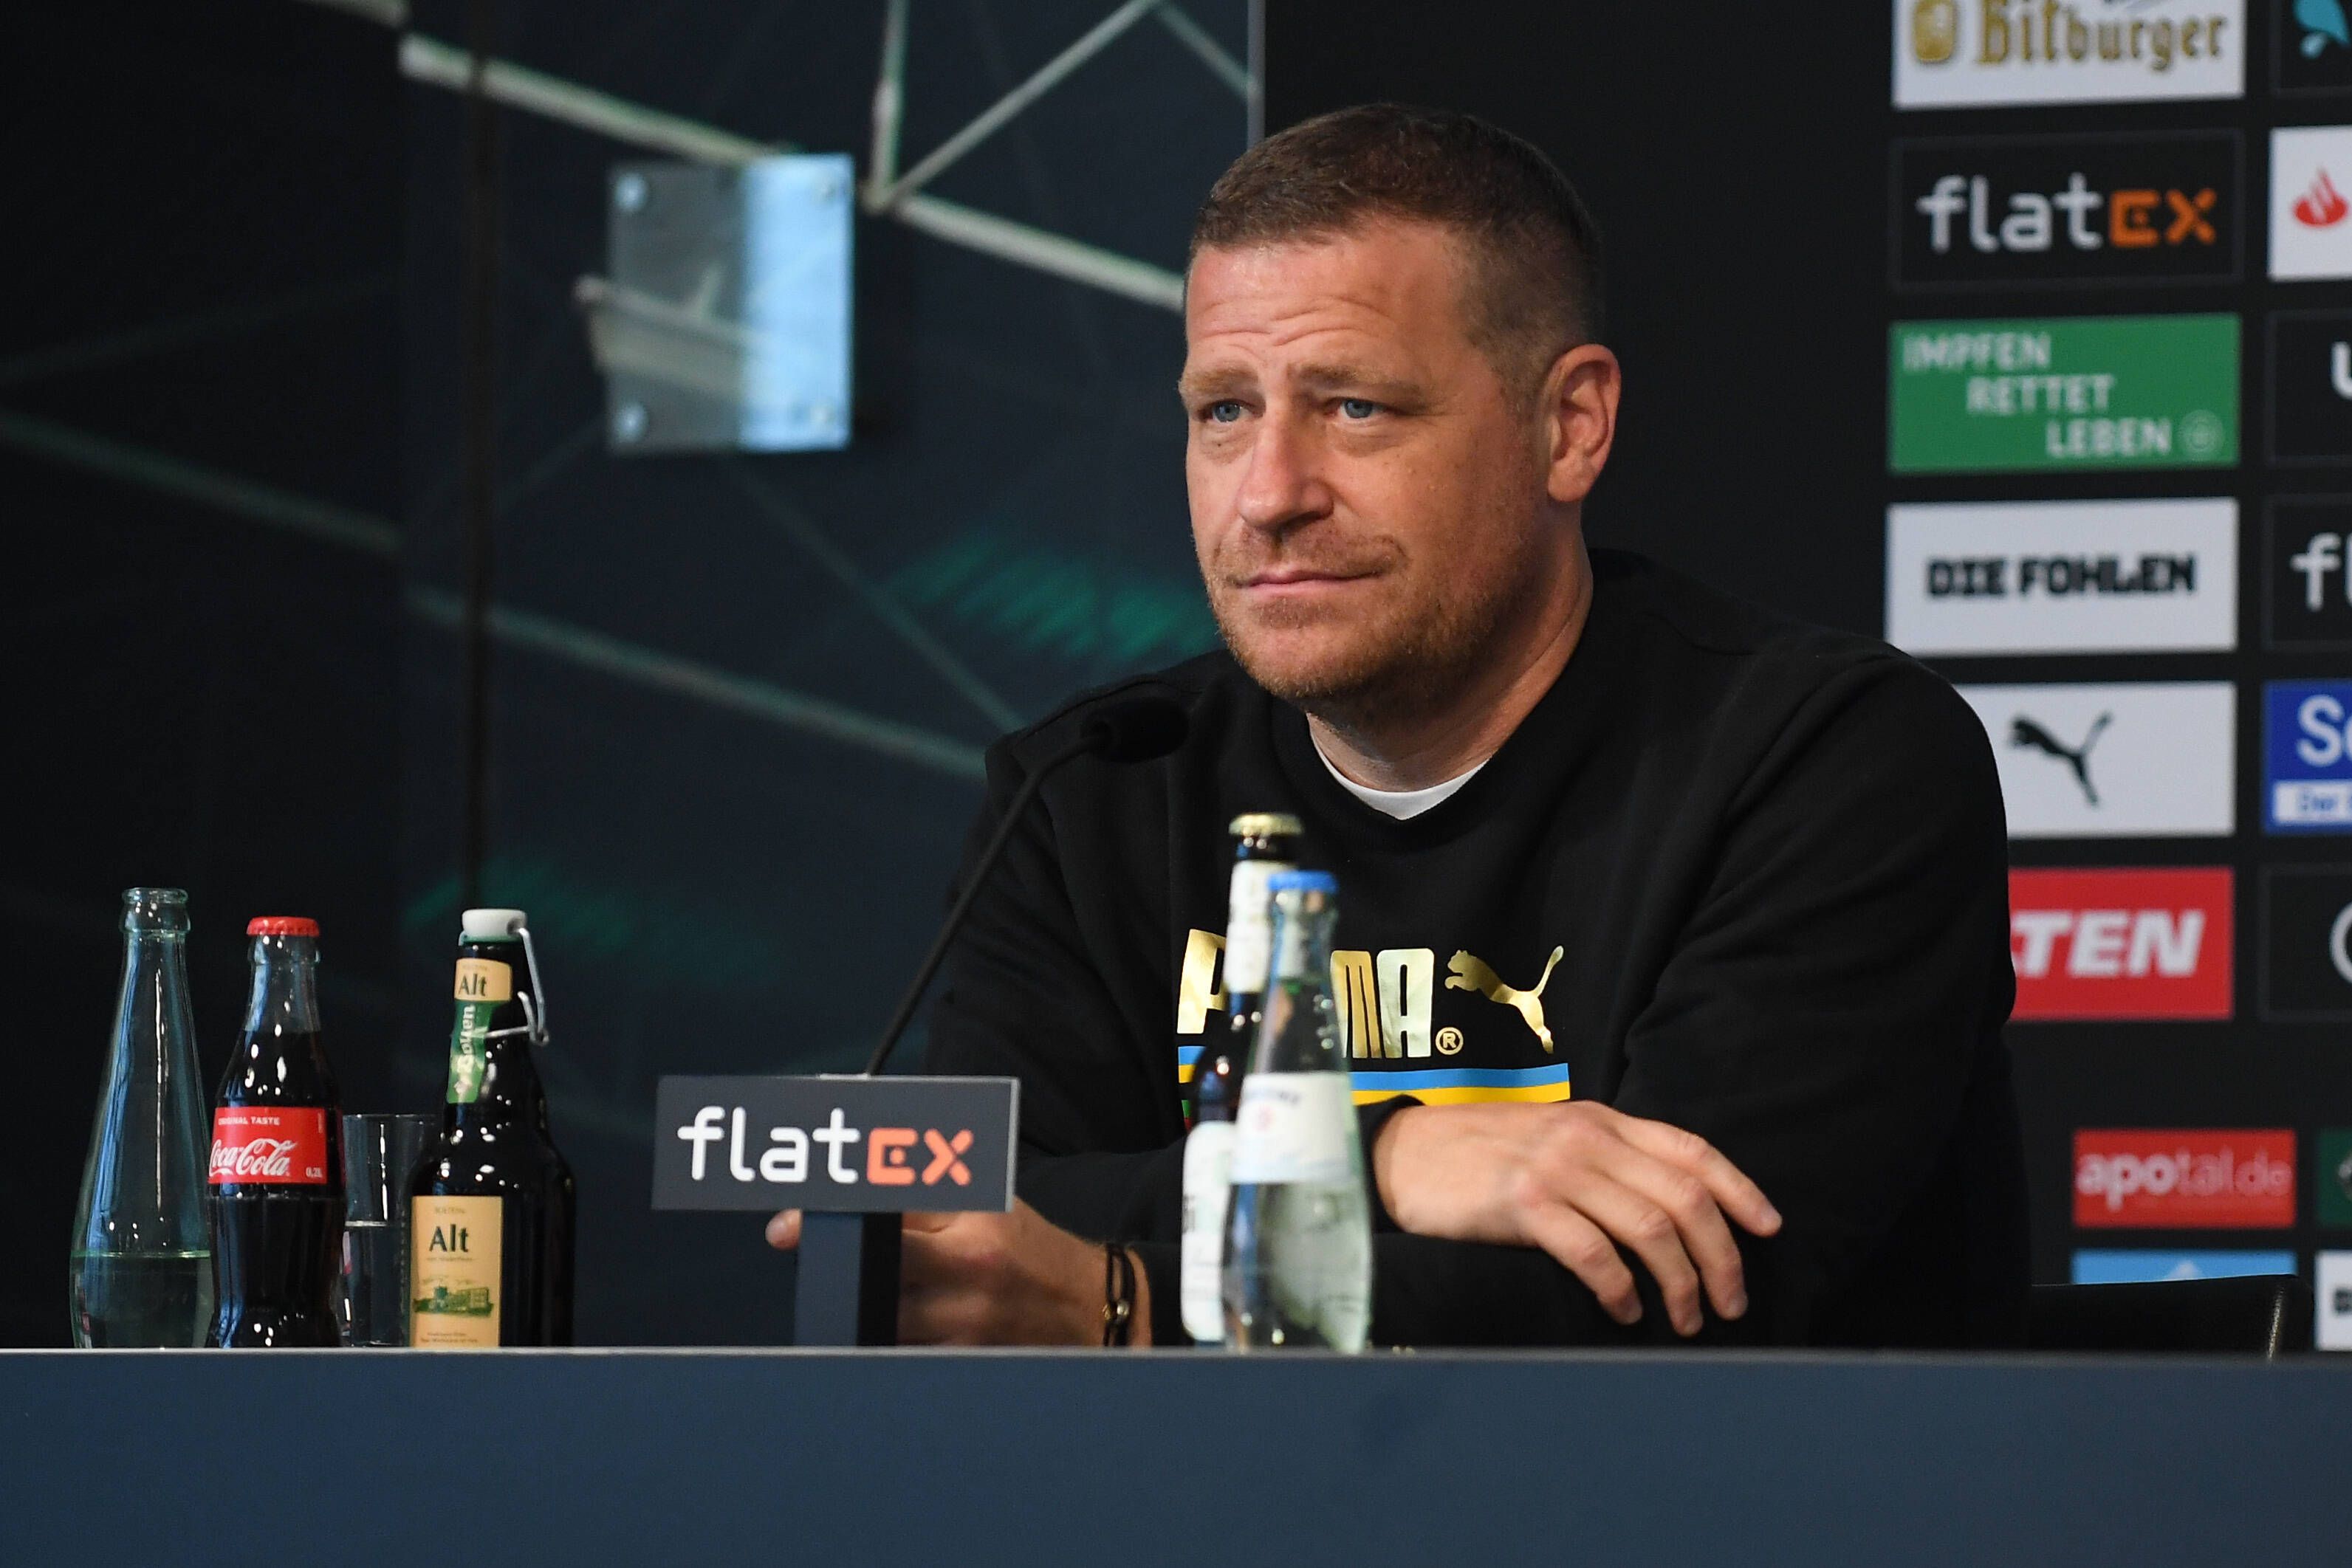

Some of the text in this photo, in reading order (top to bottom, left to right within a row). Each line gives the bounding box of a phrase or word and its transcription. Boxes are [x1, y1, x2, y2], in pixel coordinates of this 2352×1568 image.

[1904, 332, 2051, 371] IMPFEN
[1967, 374, 2115, 416] RETTET
[2045, 418, 2172, 459] LEBEN
[1927, 555, 2195, 596] DIE FOHLEN
[2011, 909, 2204, 978] TEN
[458, 974, 487, 996] Alt
[1177, 929, 1434, 1059] PMA
[251, 1116, 280, 1126] TASTE
[208, 1138, 298, 1177] Coca-Cola
[429, 1224, 469, 1253] Alt
